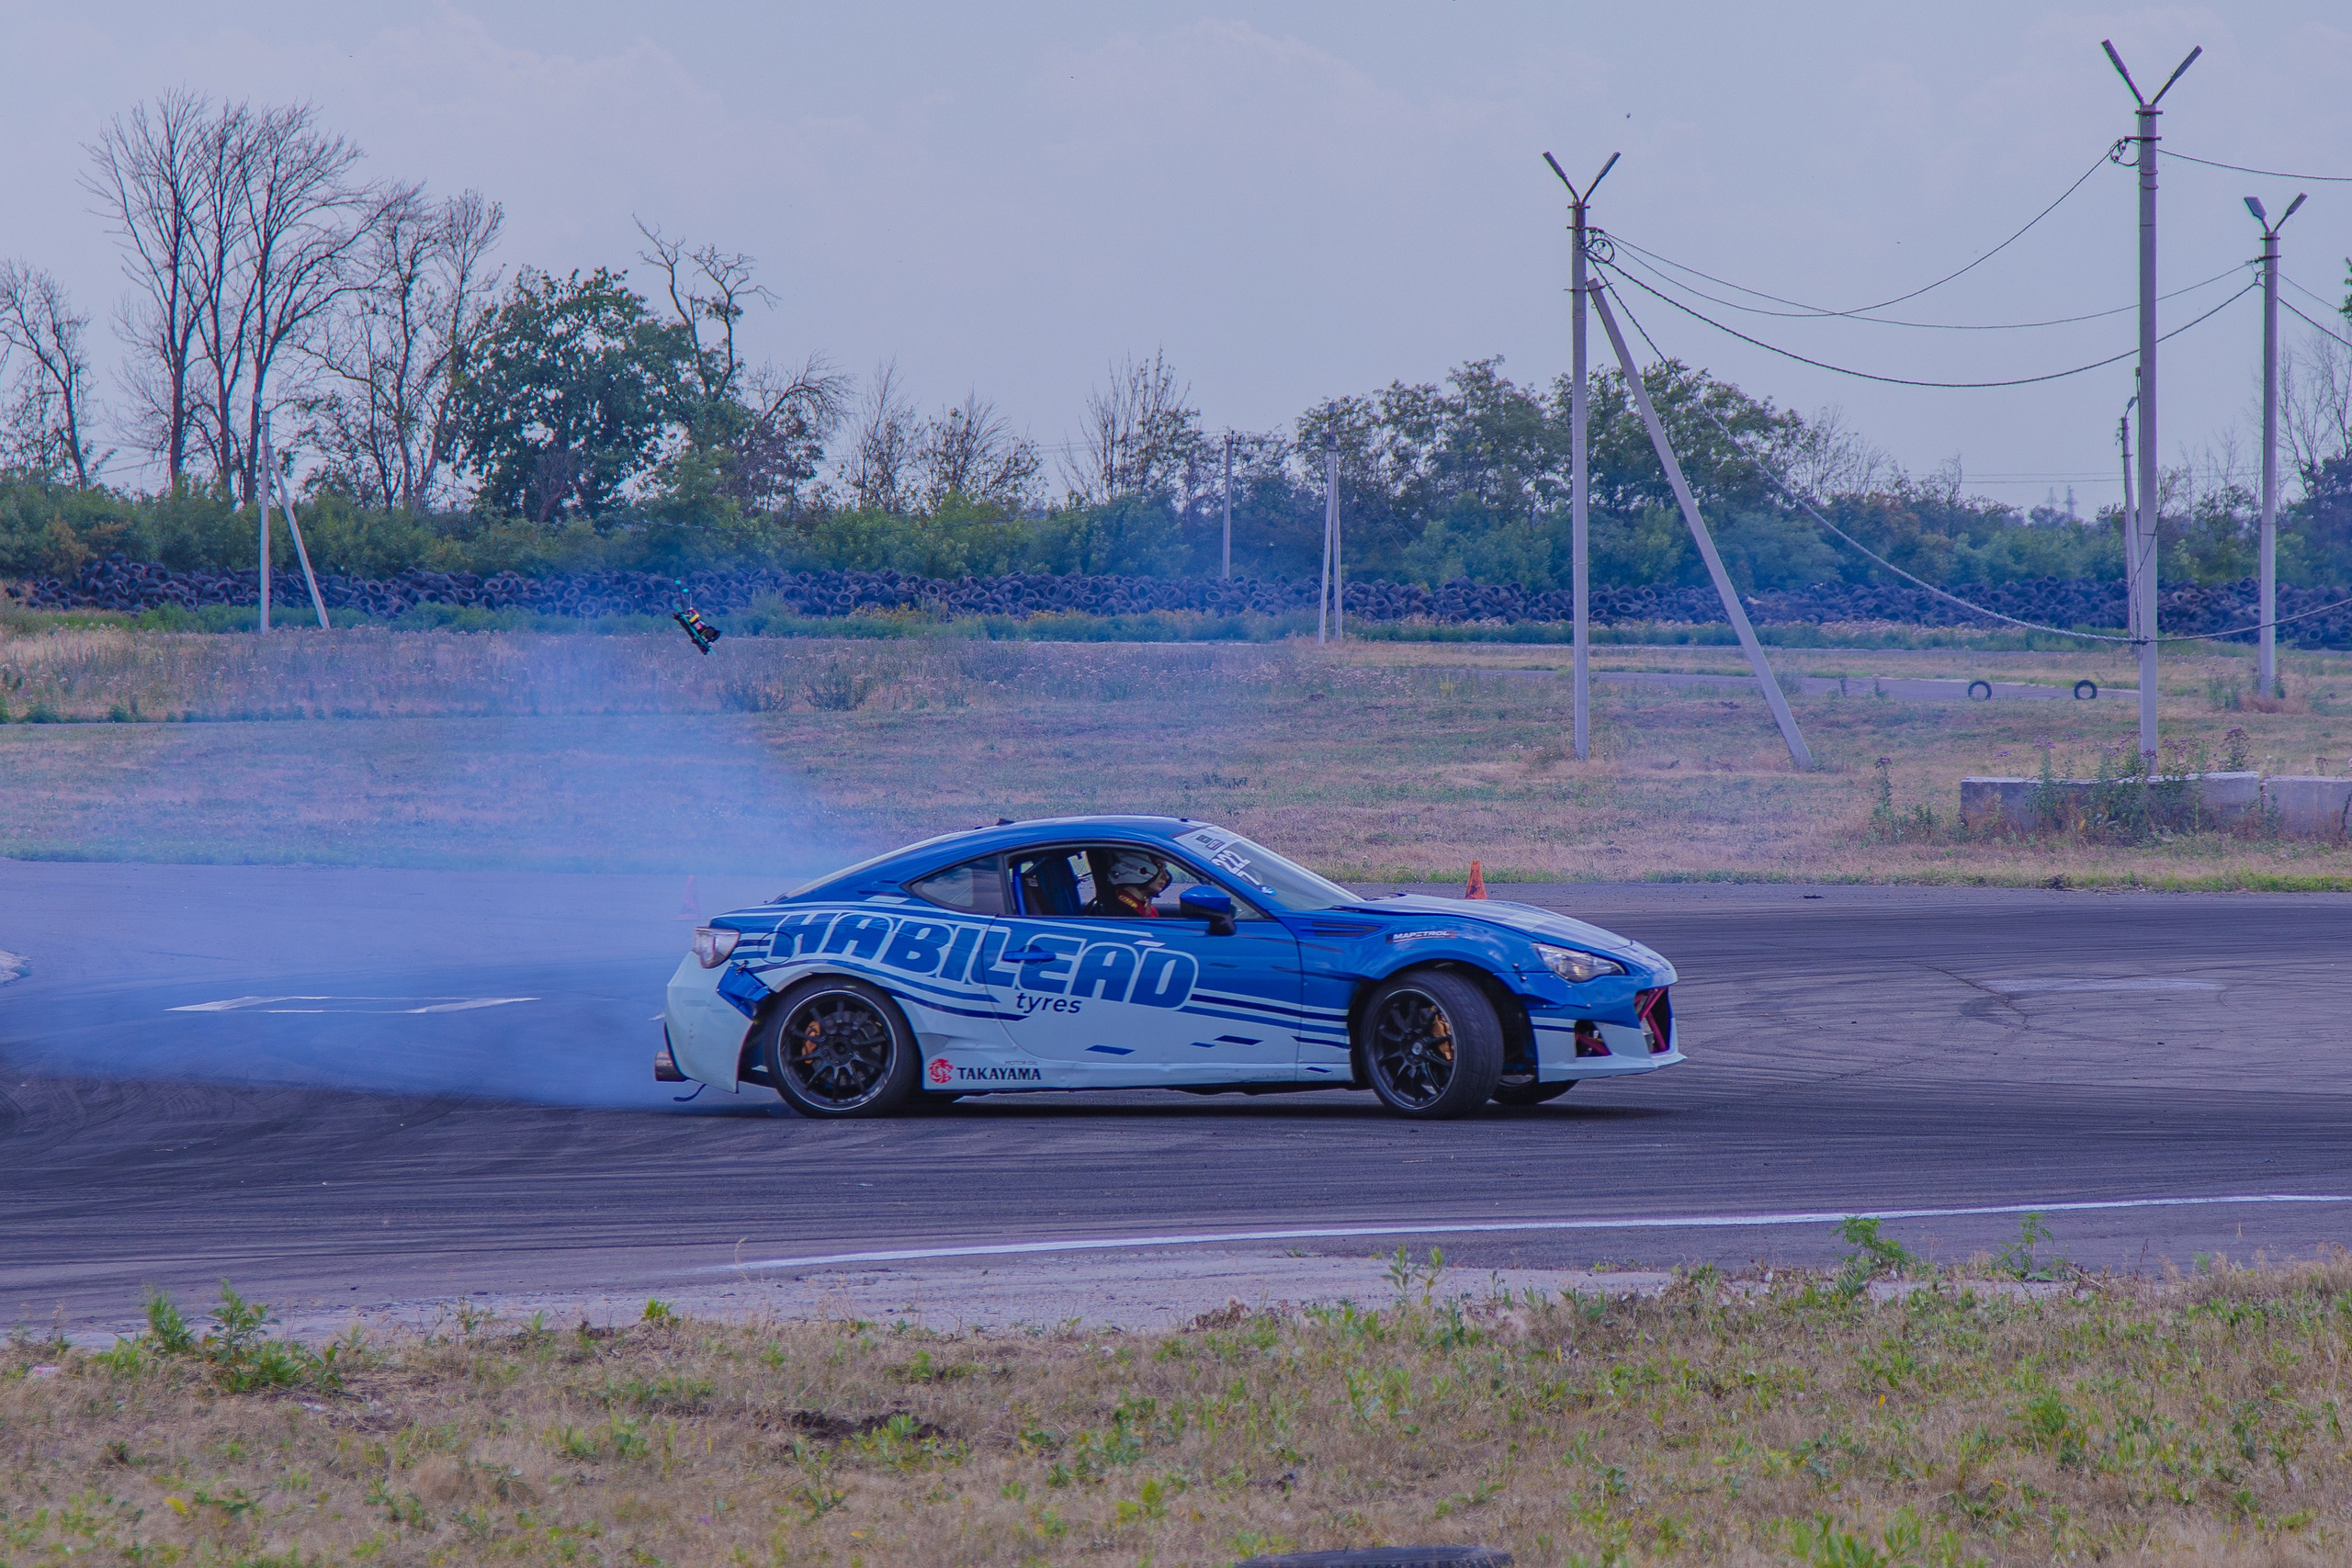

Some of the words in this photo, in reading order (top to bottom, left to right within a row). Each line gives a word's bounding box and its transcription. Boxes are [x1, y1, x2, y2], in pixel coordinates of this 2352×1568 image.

[1211, 850, 1251, 874] 222
[1392, 931, 1450, 940] MAPETROL
[766, 912, 1198, 1010] HABILEAD
[1016, 992, 1082, 1014] tyres
[956, 1067, 1041, 1080] TAKAYAMA
